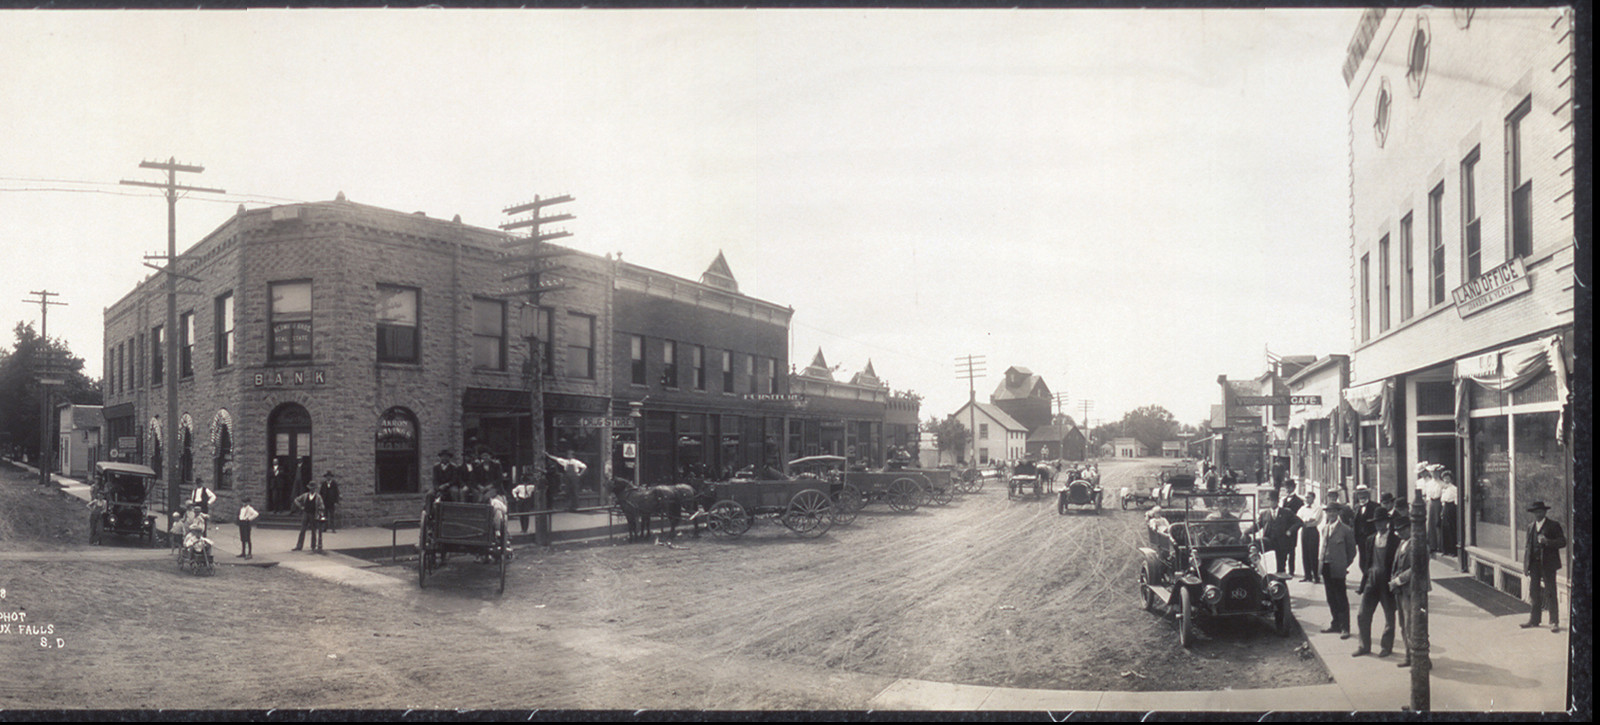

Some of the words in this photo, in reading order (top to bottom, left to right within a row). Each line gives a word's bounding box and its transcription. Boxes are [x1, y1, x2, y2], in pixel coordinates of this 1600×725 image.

[1455, 280, 1482, 304] LAND
[1481, 261, 1519, 292] OFFICE
[254, 371, 325, 387] BANK
[604, 417, 633, 427] STORE
